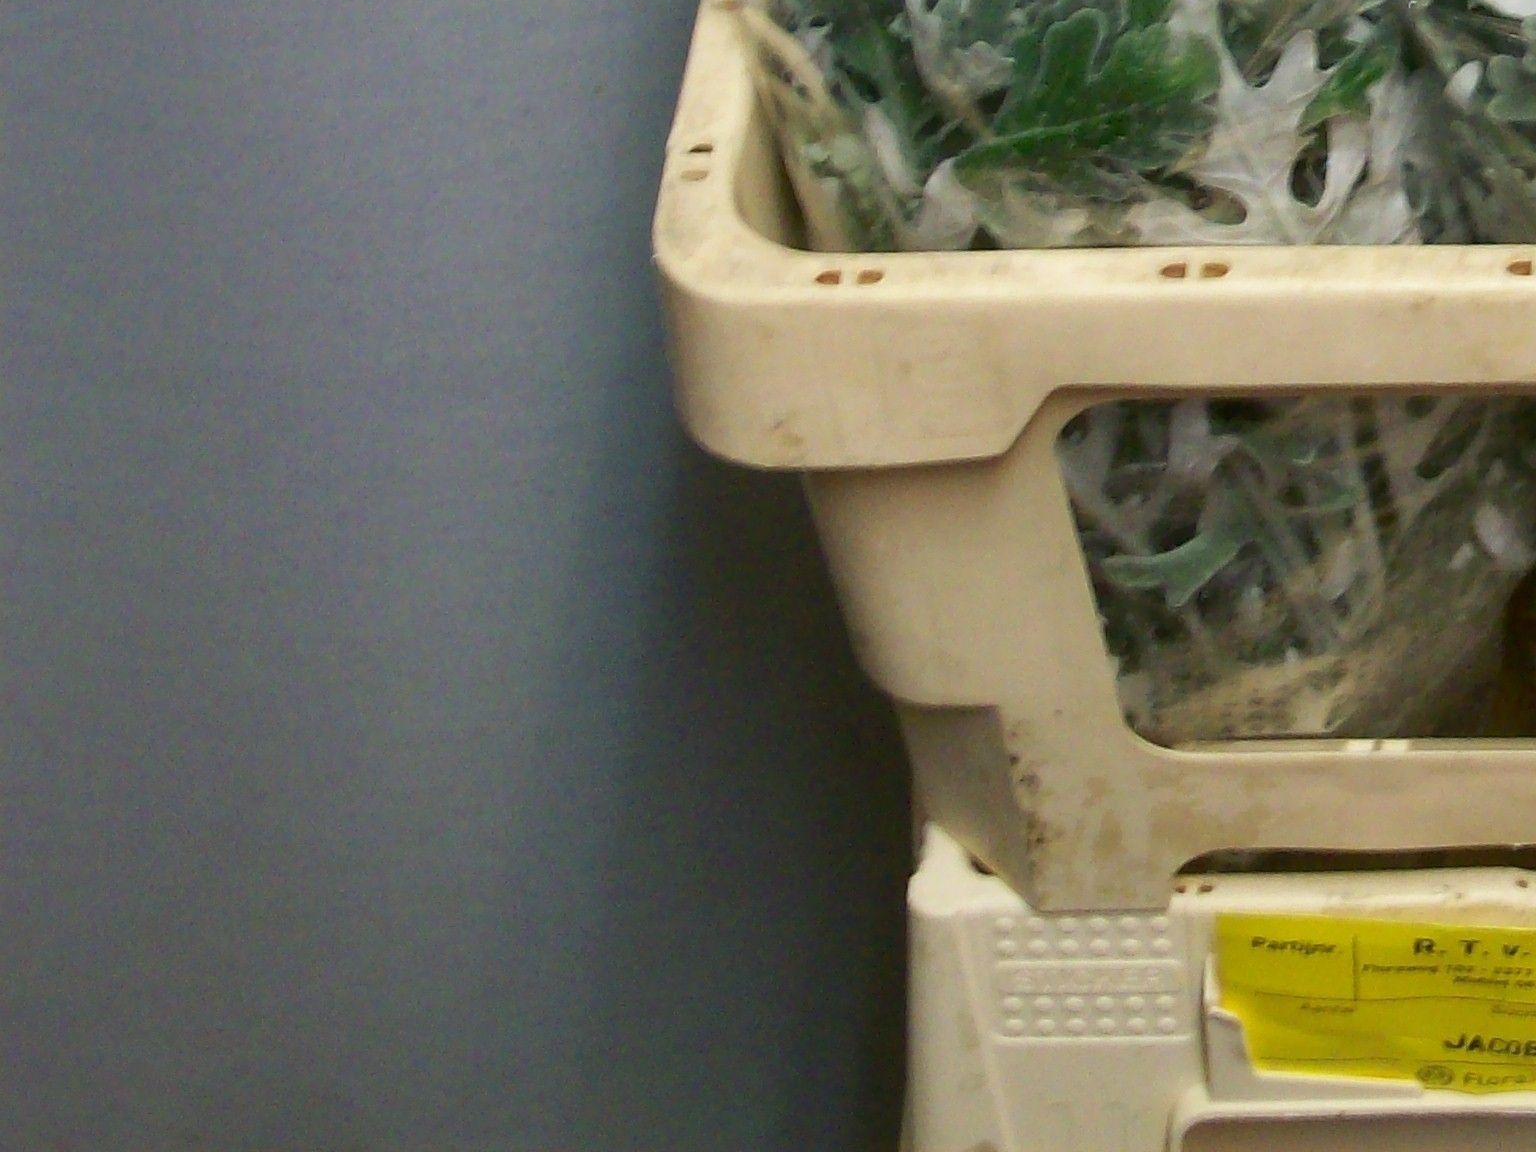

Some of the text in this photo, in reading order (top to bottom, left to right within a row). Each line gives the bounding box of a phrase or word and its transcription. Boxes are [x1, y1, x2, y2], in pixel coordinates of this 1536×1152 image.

[1413, 938, 1446, 955] R.
[1459, 939, 1487, 955] T.
[1502, 943, 1530, 957] v.
